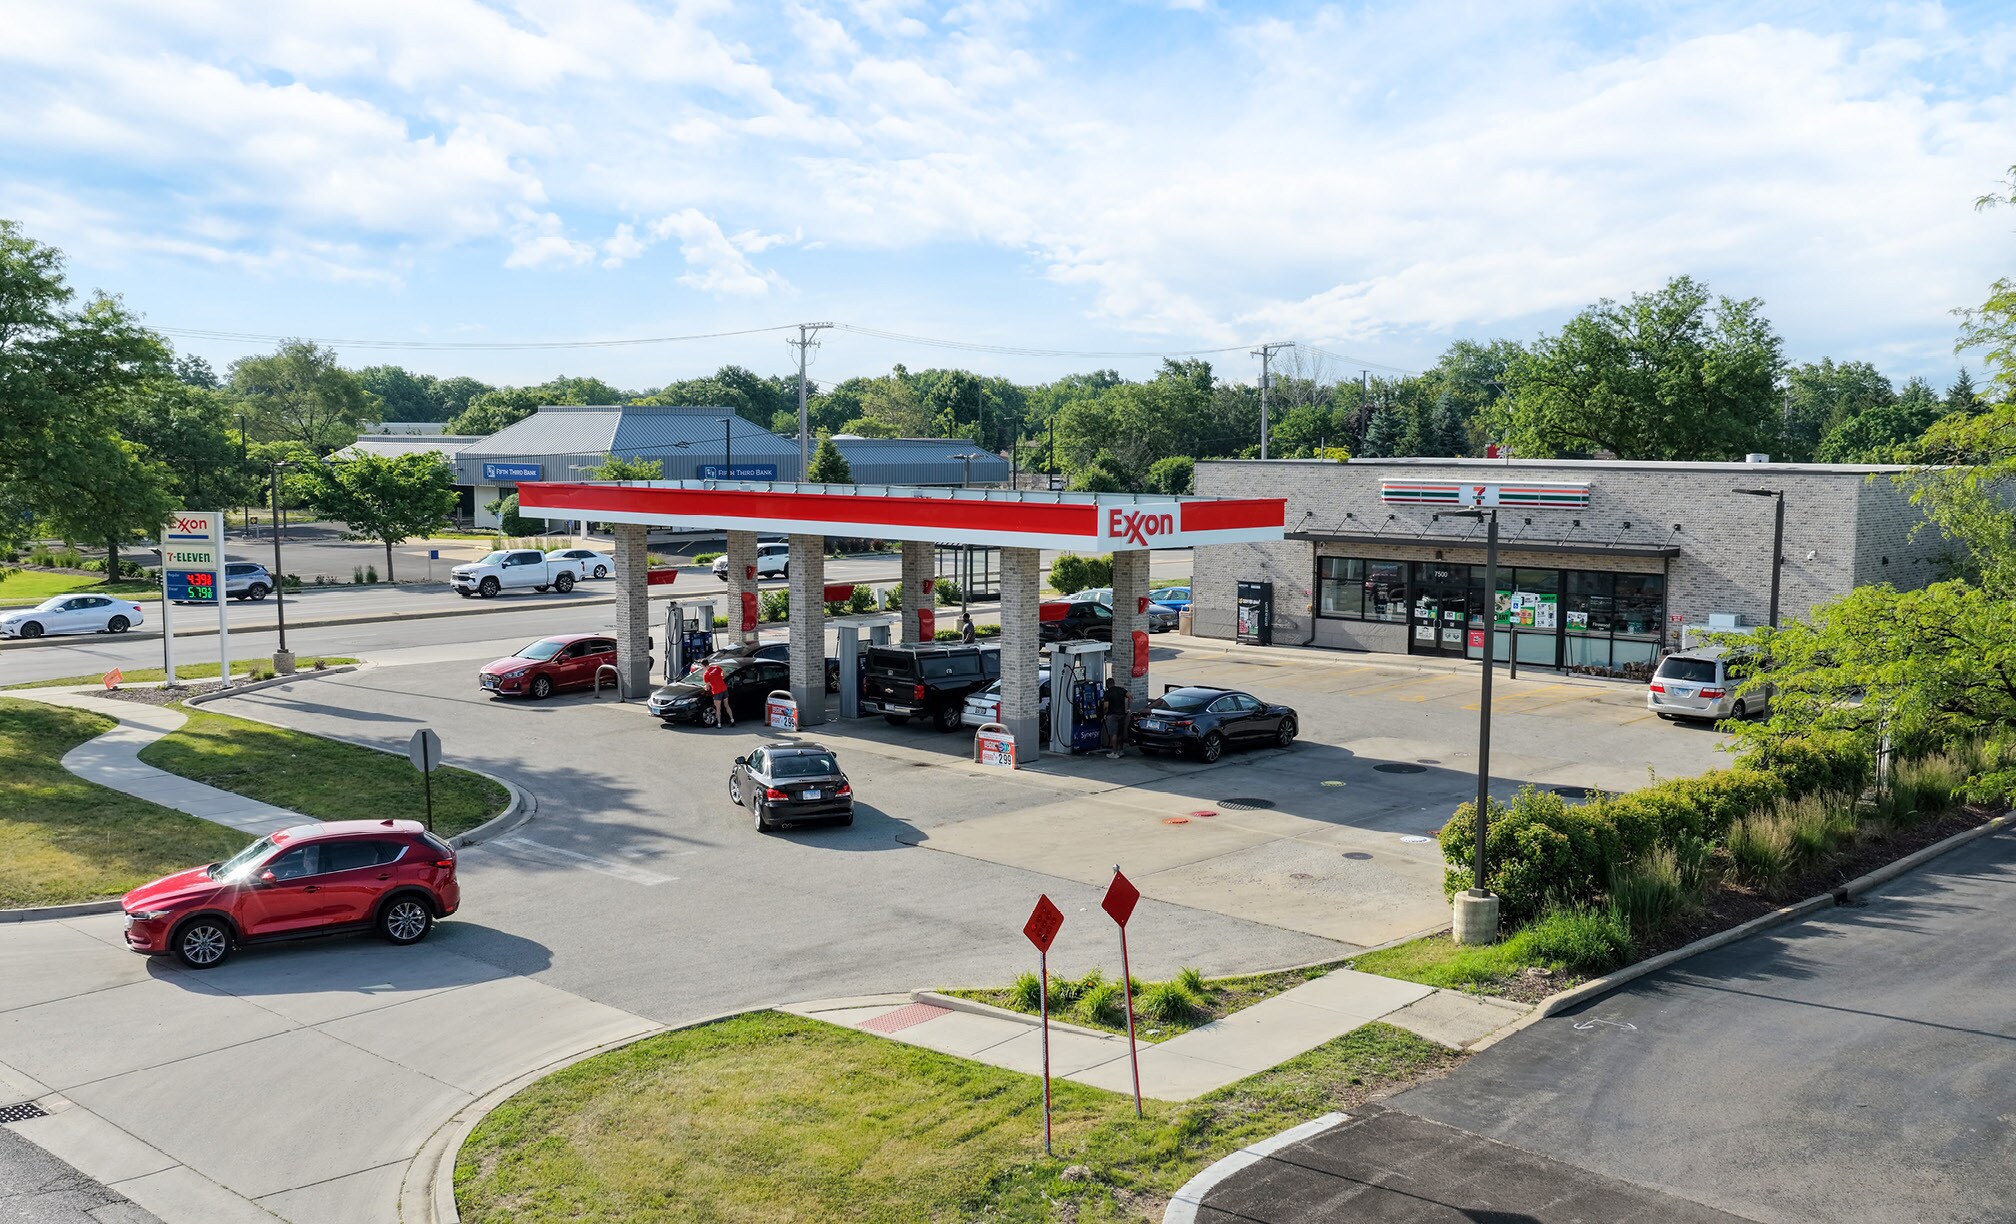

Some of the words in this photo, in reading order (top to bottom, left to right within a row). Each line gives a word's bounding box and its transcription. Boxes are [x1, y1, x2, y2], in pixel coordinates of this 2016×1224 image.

[1108, 508, 1174, 547] Exxon
[1434, 570, 1448, 578] 7500
[1080, 731, 1100, 739] Synergy
